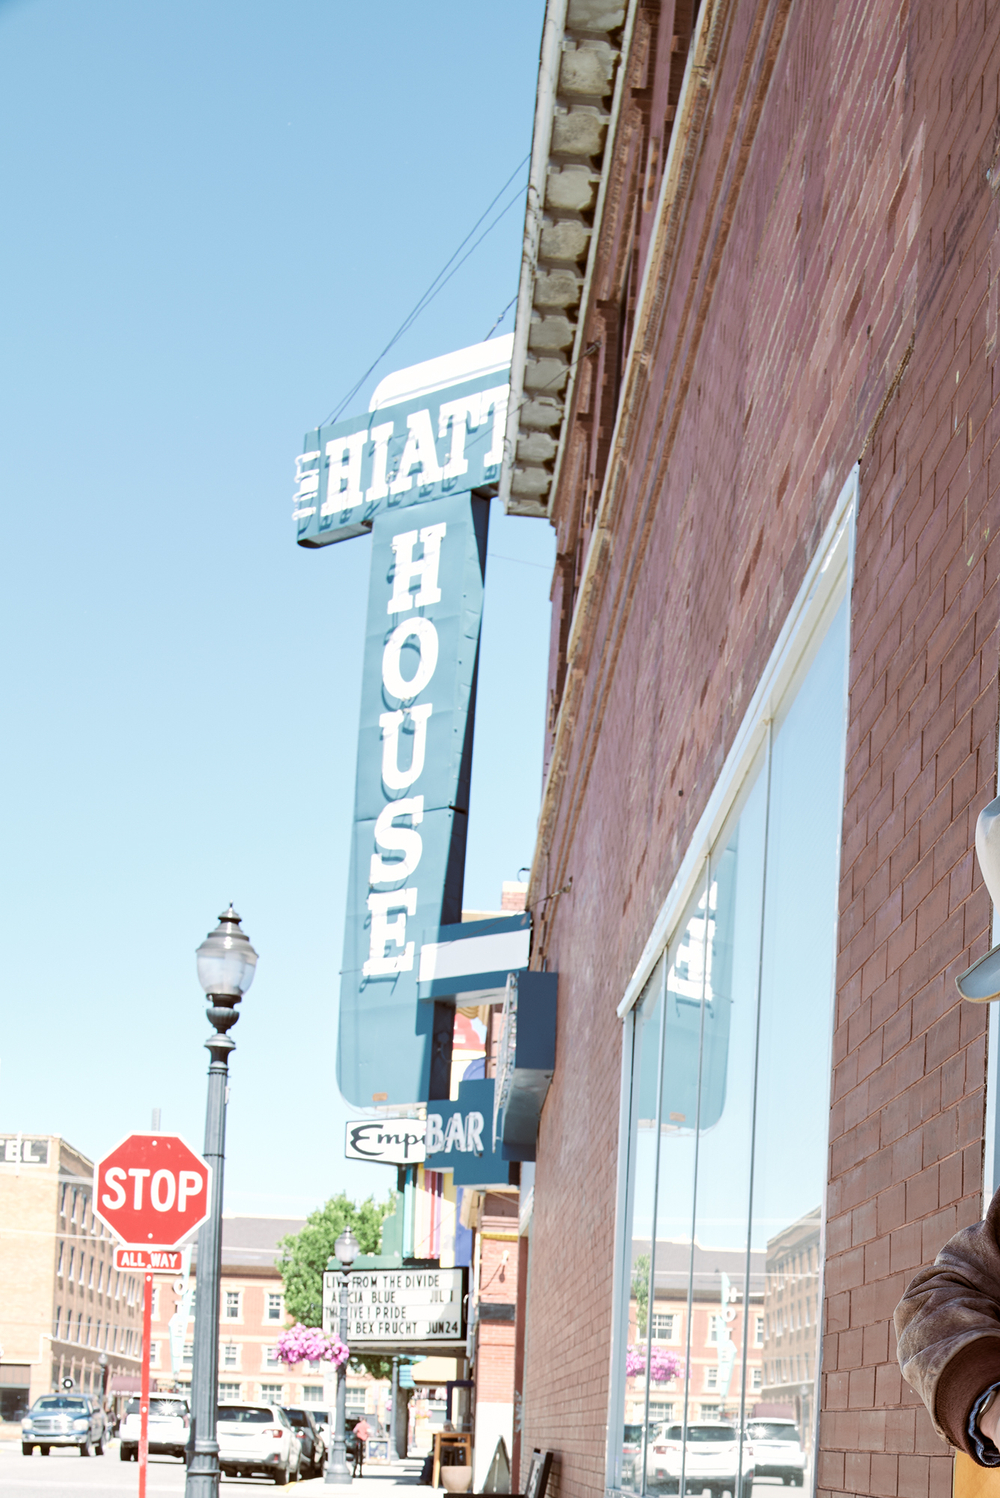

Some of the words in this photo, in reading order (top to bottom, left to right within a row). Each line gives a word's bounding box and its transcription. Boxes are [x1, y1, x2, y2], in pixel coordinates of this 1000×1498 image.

[320, 384, 510, 517] HIATT
[363, 522, 446, 977] HOUSE
[426, 1111, 484, 1154] BAR
[0, 1140, 40, 1162] EL
[102, 1167, 203, 1213] STOP
[120, 1252, 147, 1268] ALL
[150, 1252, 179, 1269] WAY
[326, 1276, 343, 1289] LIV
[352, 1276, 378, 1288] FROM
[383, 1275, 402, 1288] THE
[406, 1274, 440, 1288] DIVIDE
[372, 1291, 396, 1304] BLUE
[430, 1290, 444, 1303] JUL
[375, 1306, 407, 1318] PRIDE
[330, 1322, 352, 1334] WIH
[356, 1321, 374, 1334] BEX
[378, 1321, 417, 1334] FRUCHT
